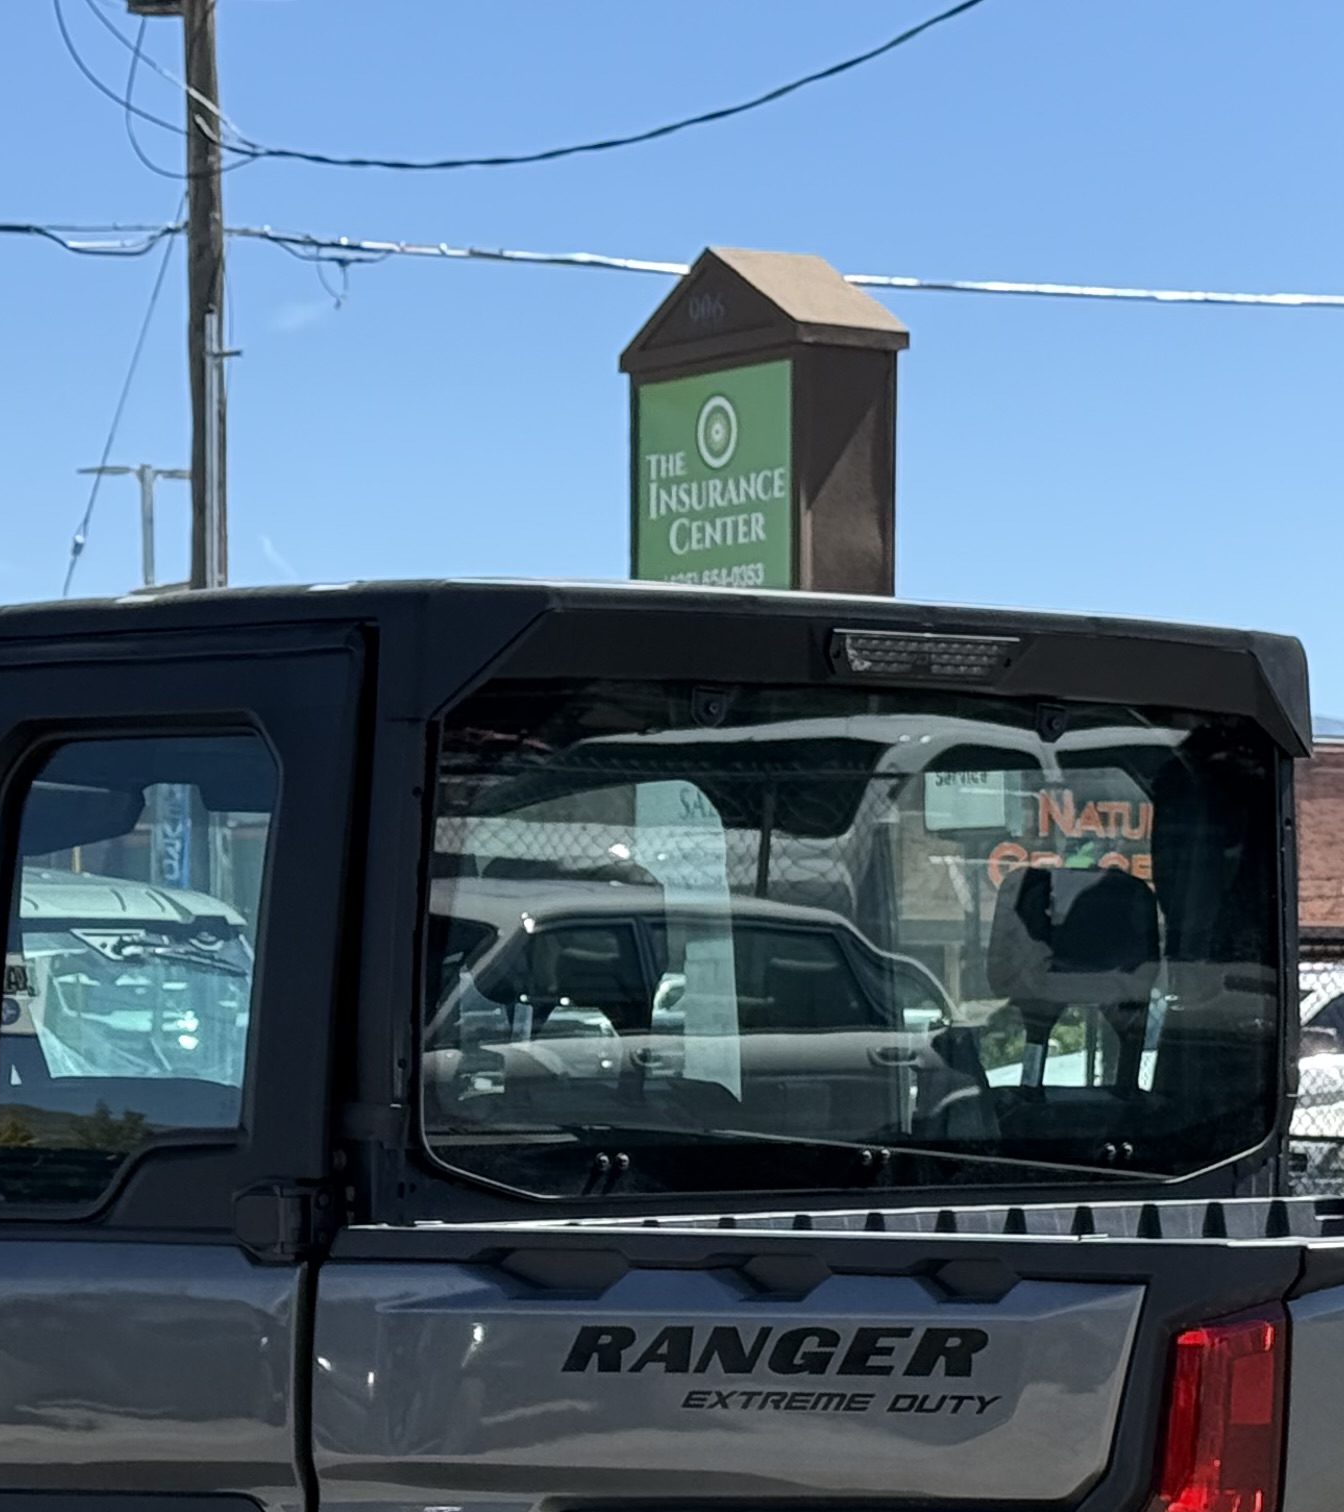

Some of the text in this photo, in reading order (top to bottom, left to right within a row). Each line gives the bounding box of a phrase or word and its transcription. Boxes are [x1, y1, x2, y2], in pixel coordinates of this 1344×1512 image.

[646, 451, 686, 480] THE
[649, 468, 787, 520] INSURANCE
[669, 512, 767, 556] CENTER
[560, 1325, 990, 1378] RANGER
[680, 1389, 1002, 1416] EXTREME DUTY
